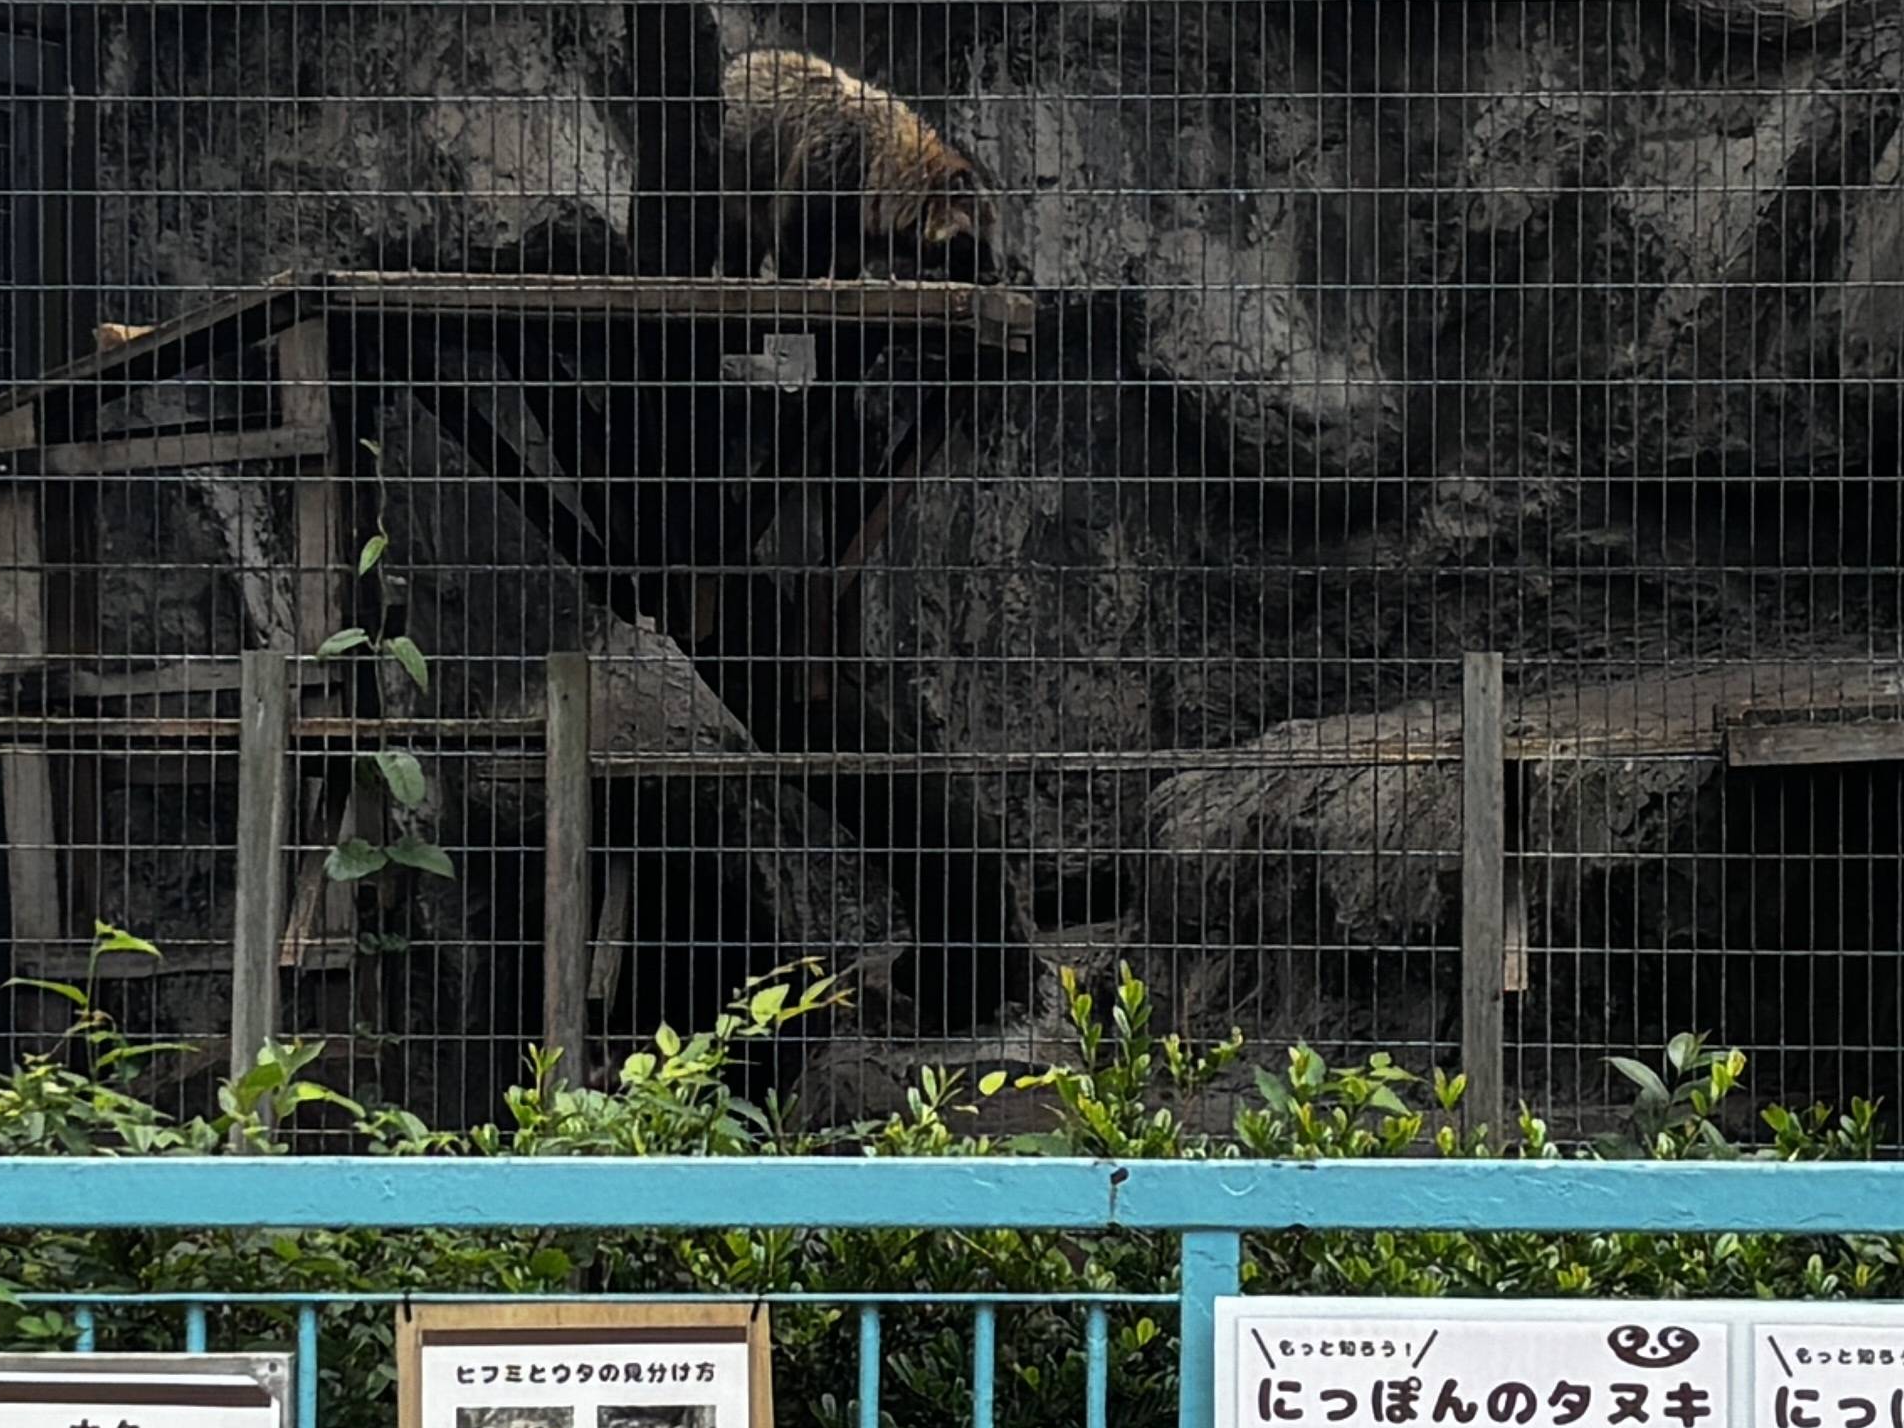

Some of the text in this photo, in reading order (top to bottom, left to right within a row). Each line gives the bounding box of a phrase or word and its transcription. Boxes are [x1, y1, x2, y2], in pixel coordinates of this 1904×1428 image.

[1279, 1338, 1413, 1358] もっと知ろう！
[456, 1361, 716, 1385] ヒフミとウタの見分け方
[1257, 1377, 1711, 1428] にっぽんのタヌキ
